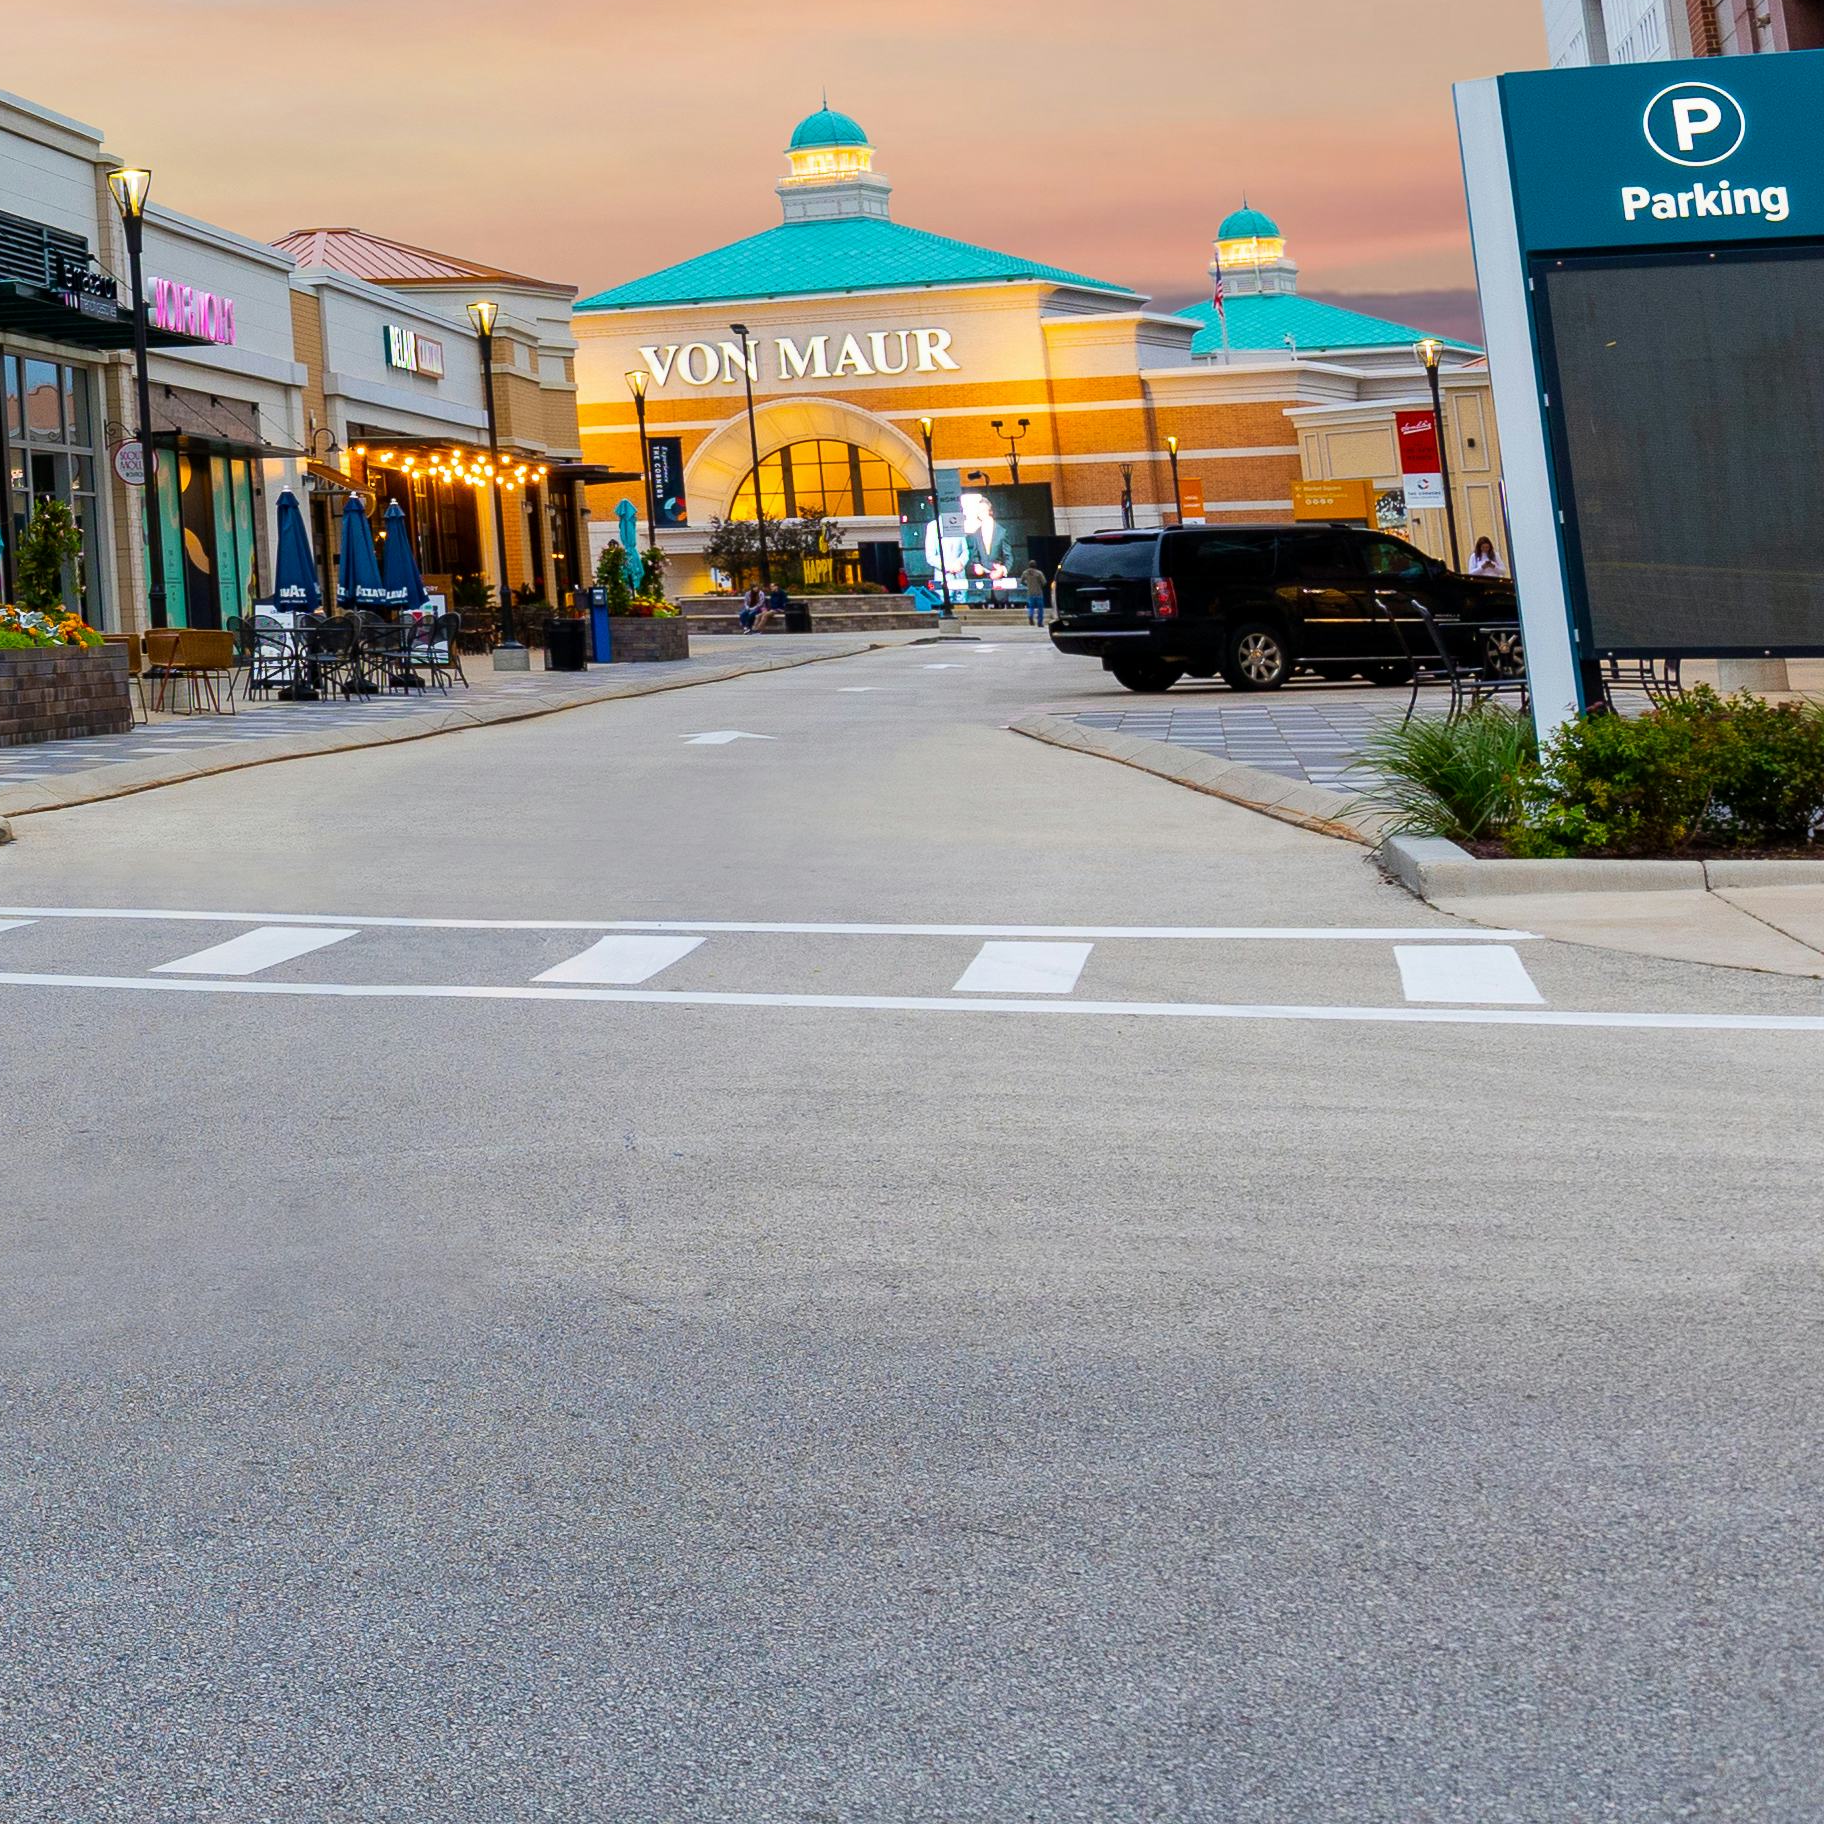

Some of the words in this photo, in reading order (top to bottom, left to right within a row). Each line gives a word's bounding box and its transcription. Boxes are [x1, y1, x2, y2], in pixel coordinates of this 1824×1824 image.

[1672, 97, 1722, 152] P
[1621, 179, 1790, 222] Parking
[638, 339, 760, 387] VON
[774, 328, 961, 380] MAUR
[803, 558, 833, 584] HAPPY
